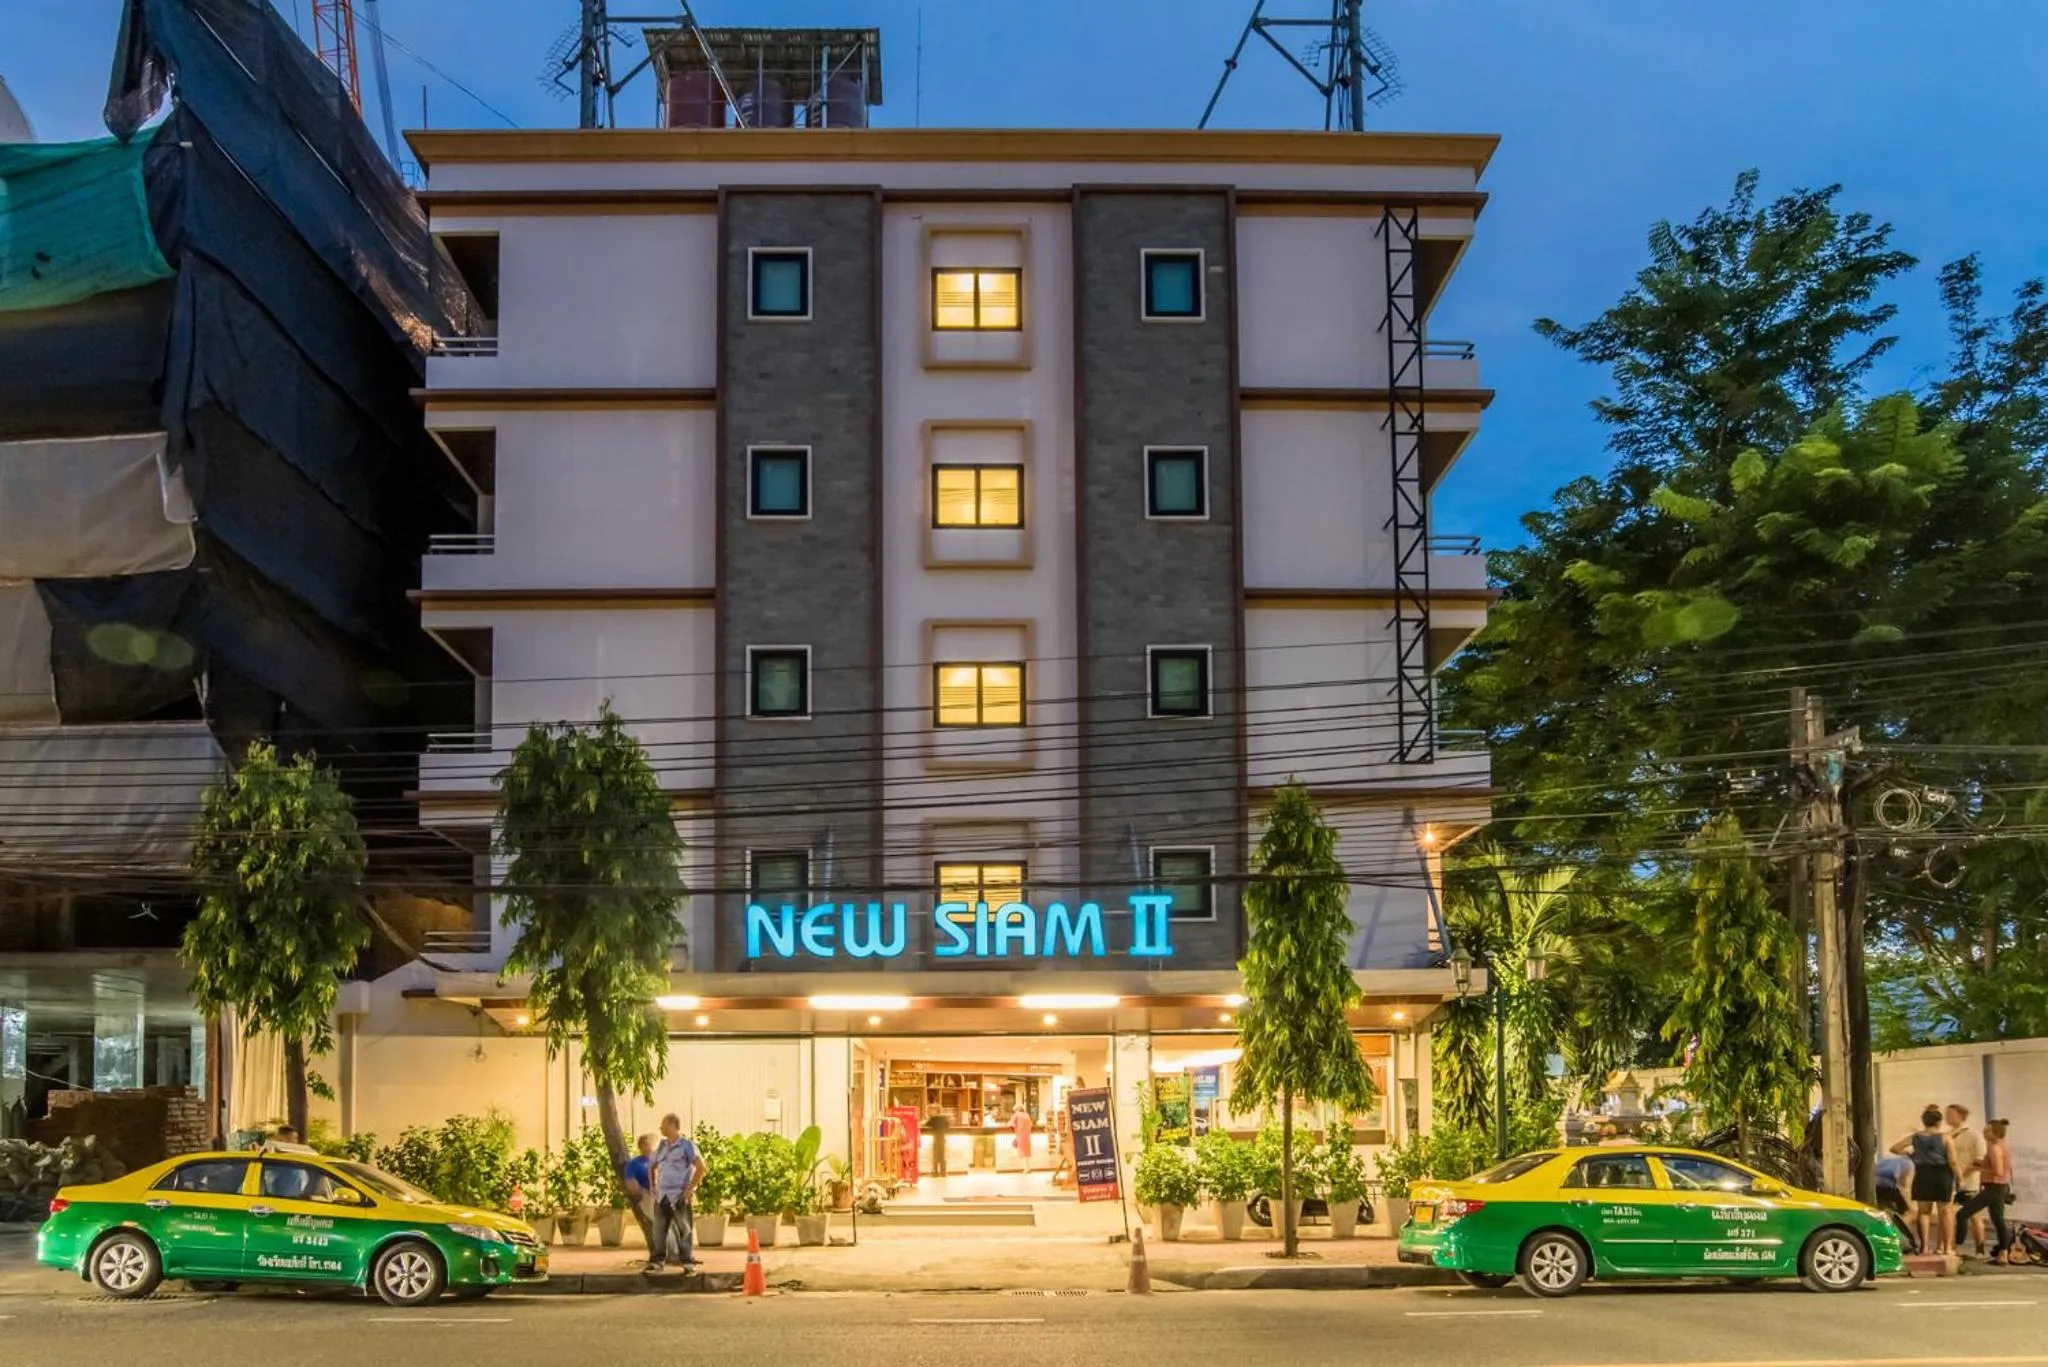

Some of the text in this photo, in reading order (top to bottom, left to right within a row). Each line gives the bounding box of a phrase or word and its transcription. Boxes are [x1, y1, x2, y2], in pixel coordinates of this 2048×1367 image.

[746, 895, 1175, 958] NEW SIAM II
[1071, 1100, 1106, 1115] NEW
[1072, 1117, 1109, 1131] SIAM
[1084, 1134, 1102, 1156] II
